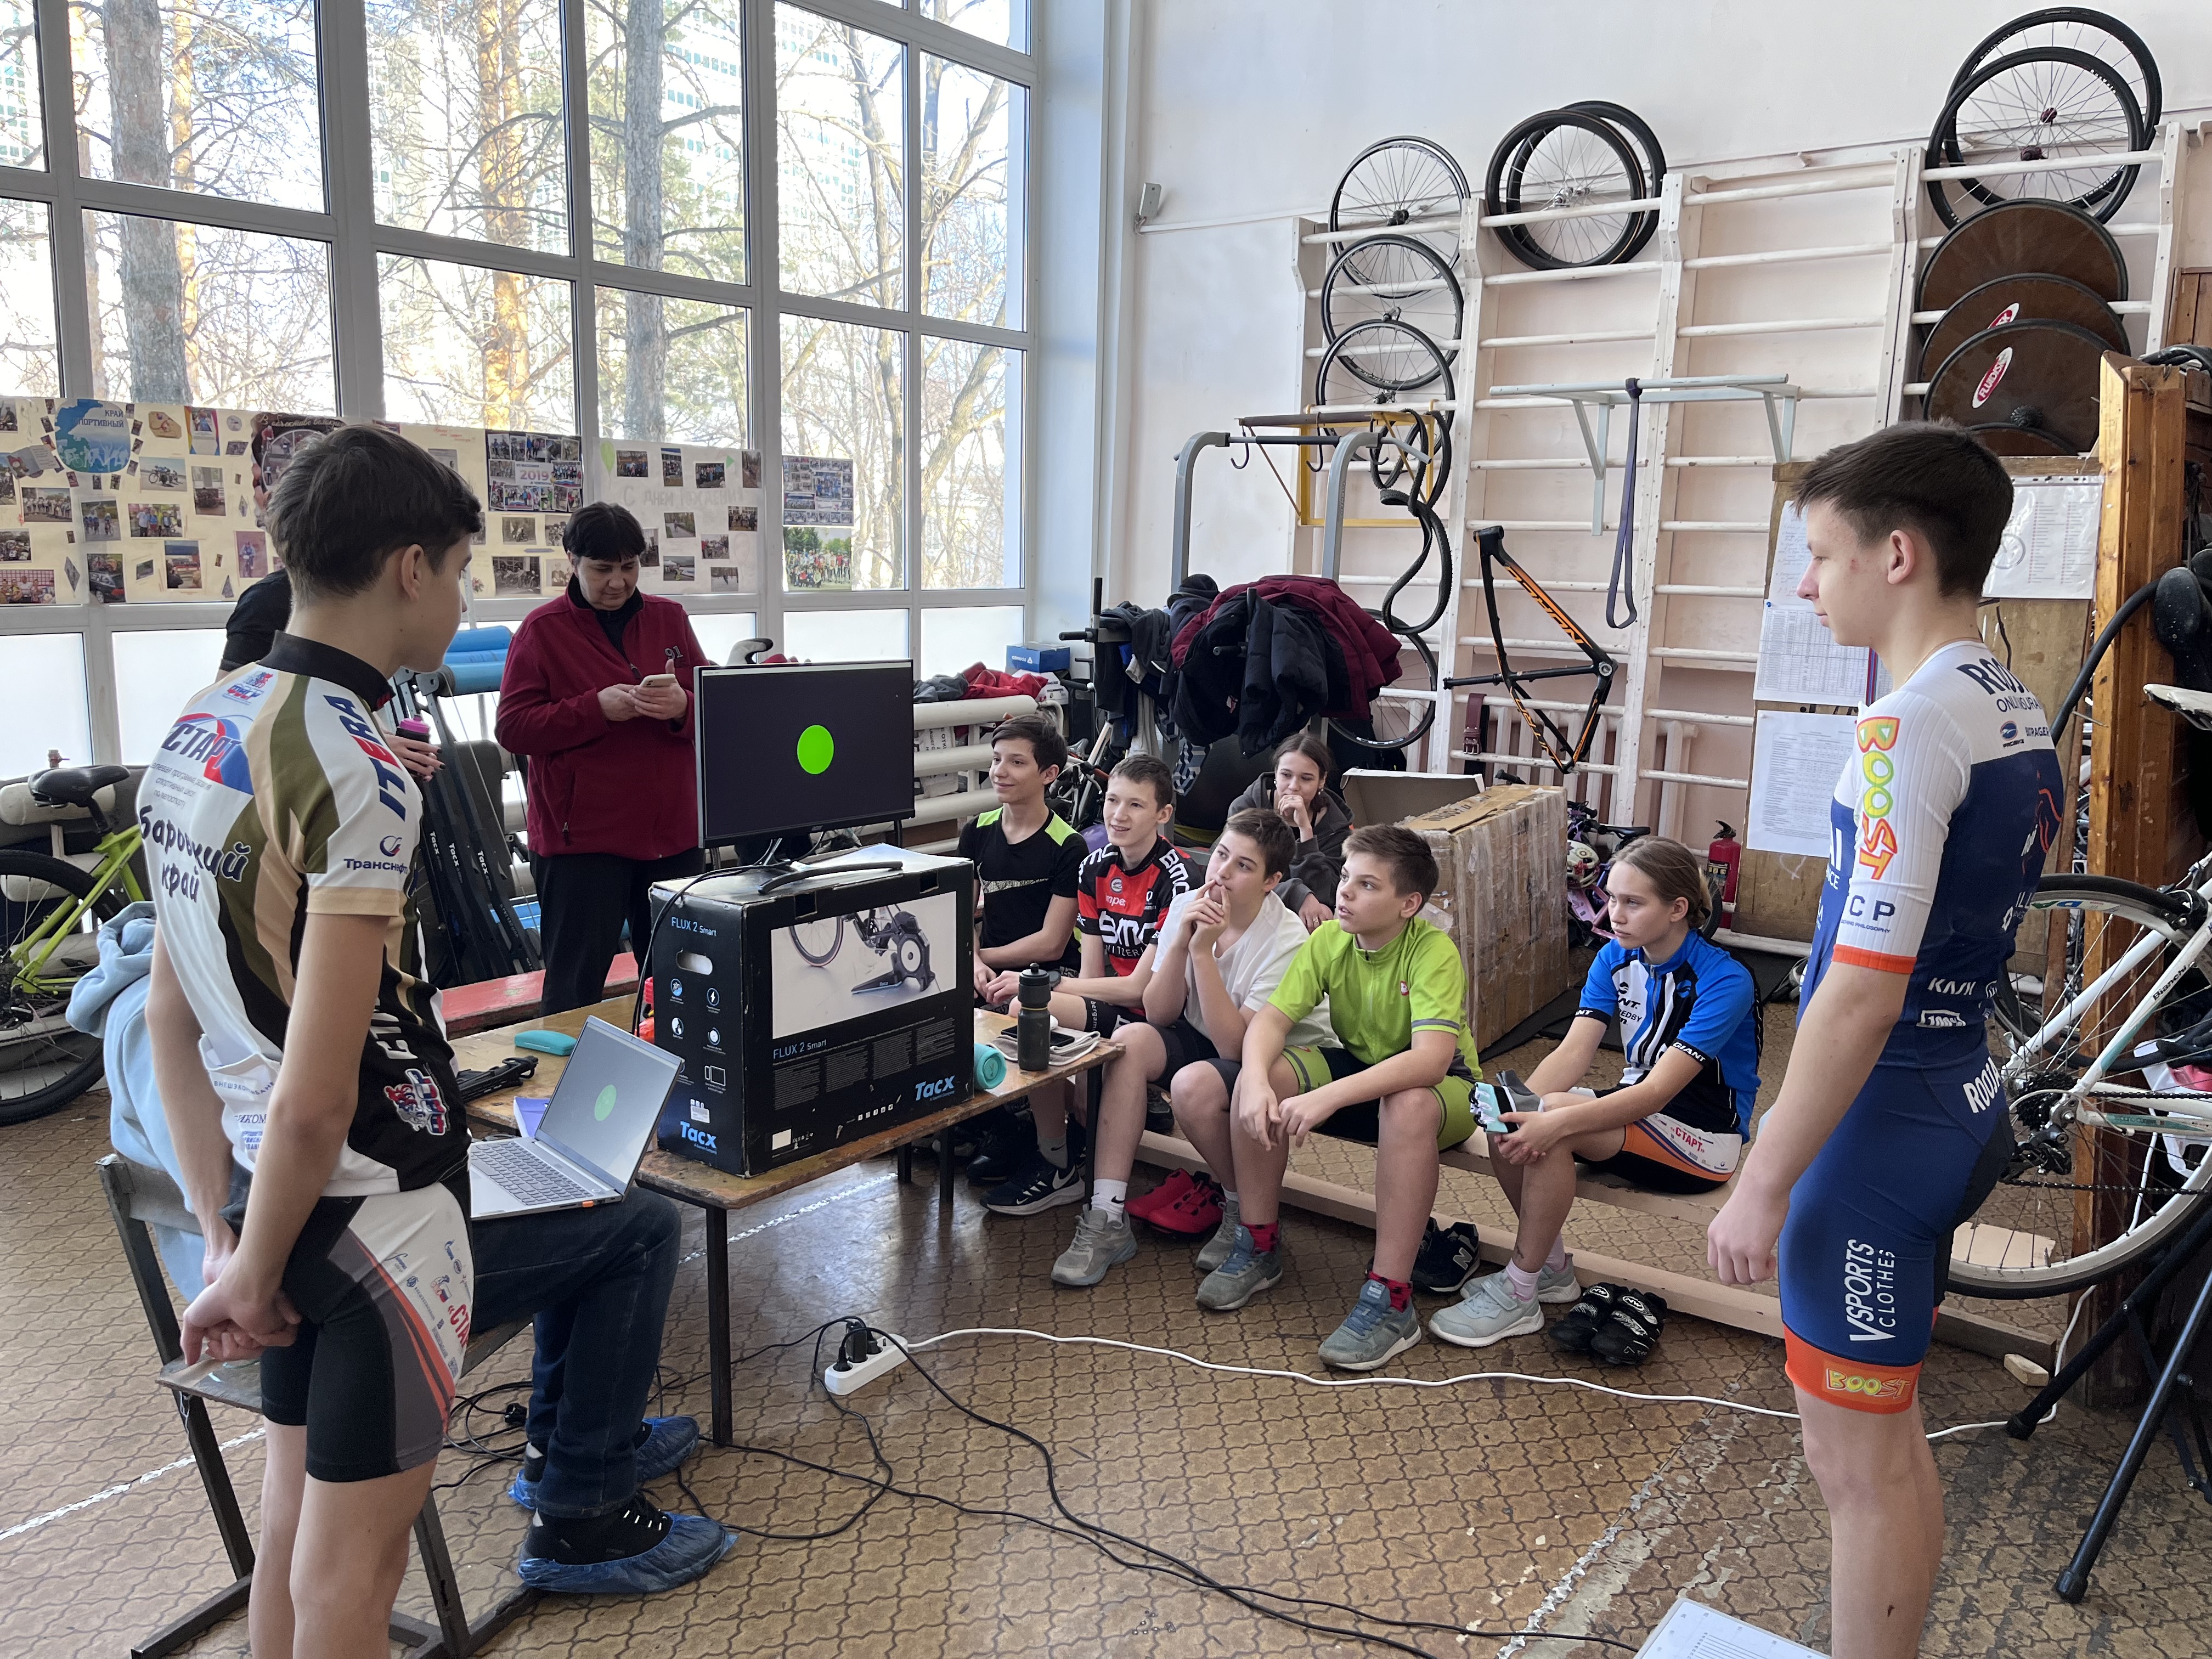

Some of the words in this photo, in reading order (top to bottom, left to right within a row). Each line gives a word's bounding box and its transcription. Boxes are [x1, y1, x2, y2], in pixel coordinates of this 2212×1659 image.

[520, 470, 549, 481] 2019
[1504, 566, 1584, 644] NORCO
[664, 645, 684, 660] 91
[161, 723, 242, 769] СТАРТ
[323, 695, 406, 822] ITERA
[1857, 716, 1899, 881] BOOST
[430, 831, 439, 855] Tacx
[449, 843, 460, 867] Tacx
[477, 850, 489, 874] Tacx
[162, 862, 200, 903] край
[672, 917, 691, 930] FLUX
[693, 922, 698, 932] 2
[699, 926, 717, 936] Smart
[2152, 964, 2187, 1001] Bianchi
[773, 1043, 797, 1059] FLUX
[799, 1042, 805, 1052] 2
[807, 1039, 827, 1050] Smart
[1673, 1042, 1706, 1062] GIANT
[915, 1075, 955, 1101] Tacx
[680, 1121, 716, 1149] Tacx
[1844, 1239, 1896, 1341] VSPORTS
[1826, 1368, 1911, 1398] BOOST
